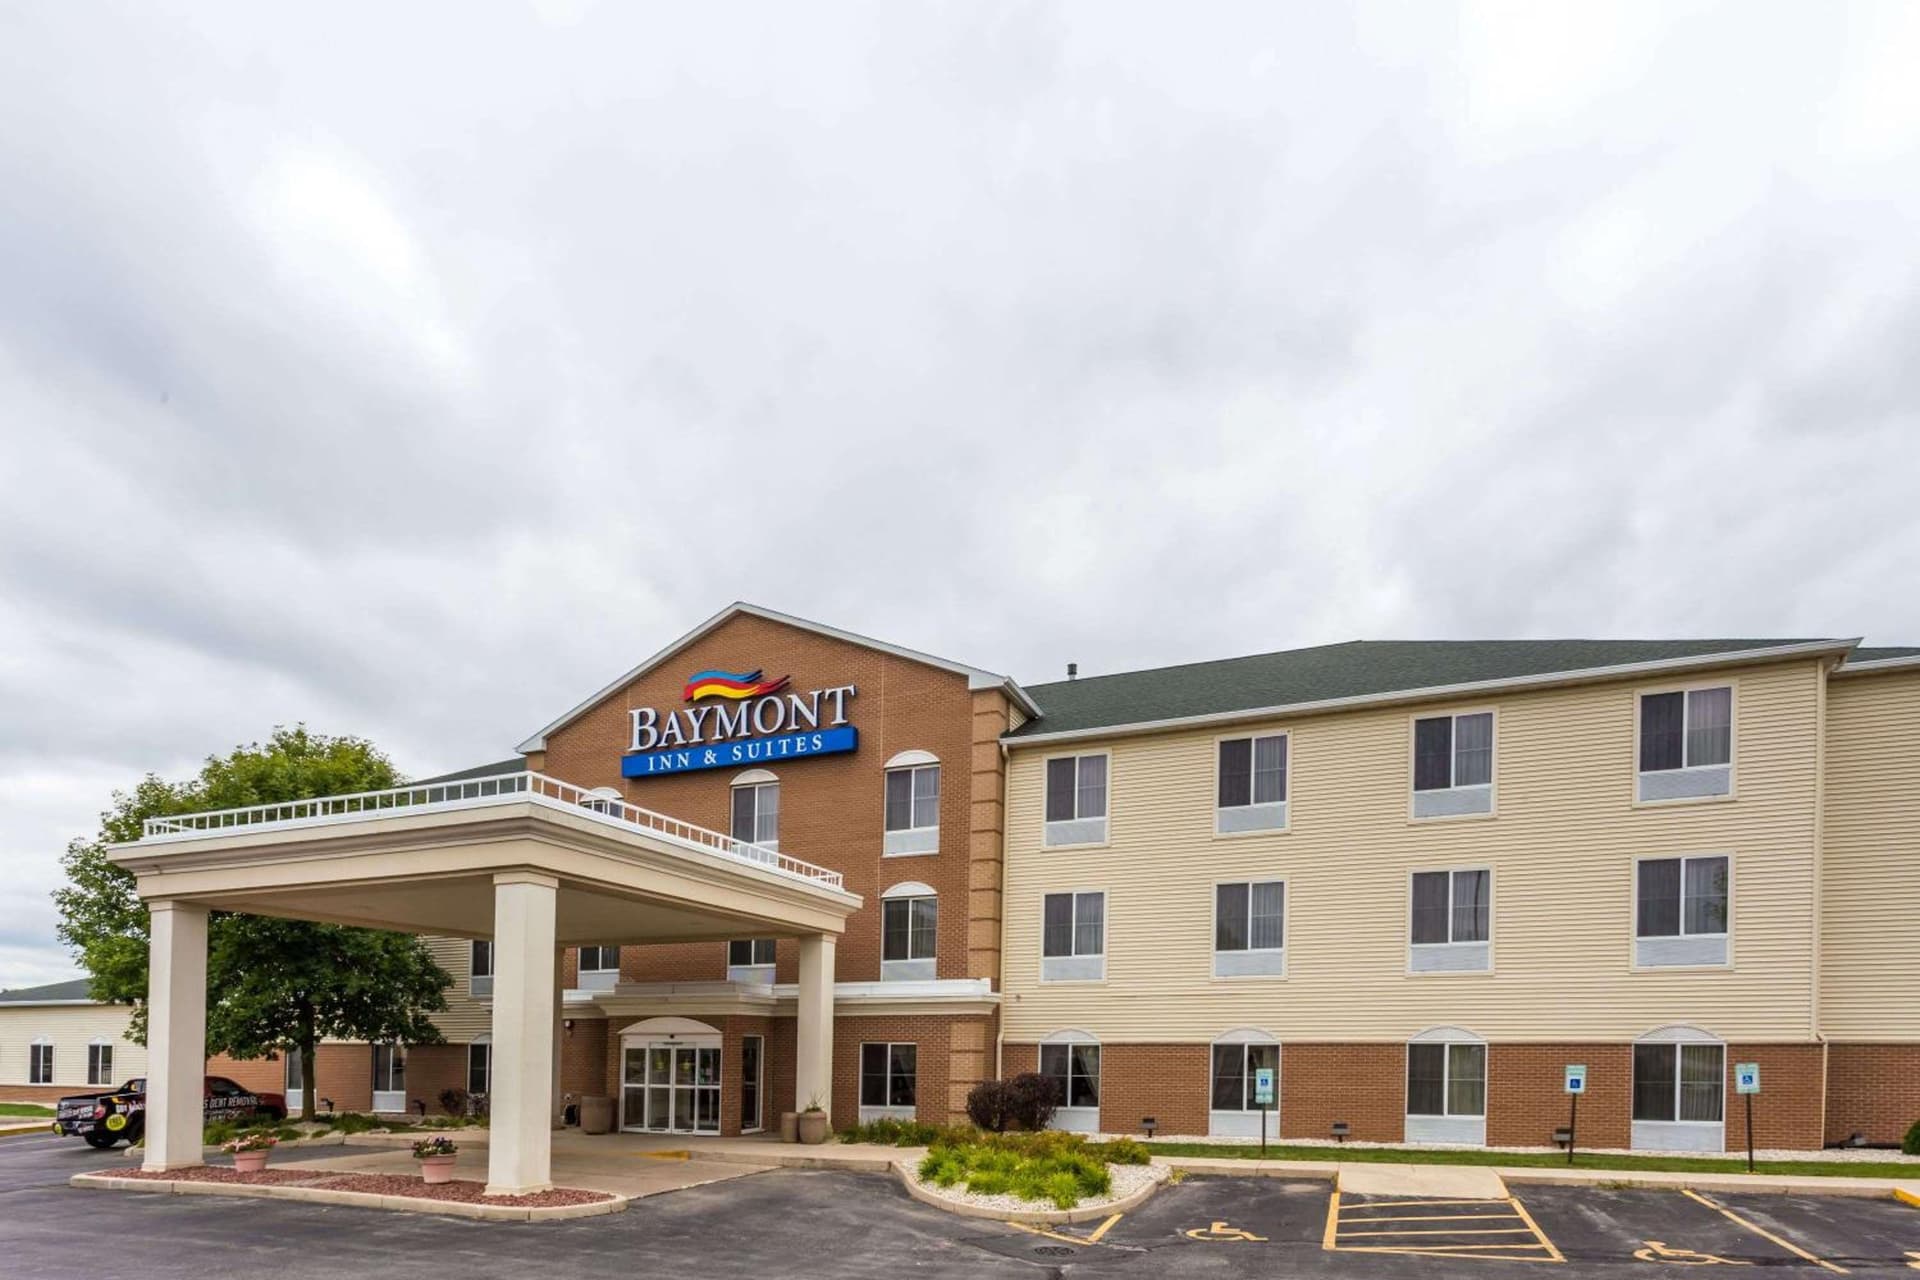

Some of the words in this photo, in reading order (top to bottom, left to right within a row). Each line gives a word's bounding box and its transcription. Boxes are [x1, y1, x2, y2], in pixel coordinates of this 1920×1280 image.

[628, 684, 855, 752] BAYMONT
[648, 752, 690, 771] INN
[703, 749, 717, 765] &
[732, 734, 823, 761] SUITES
